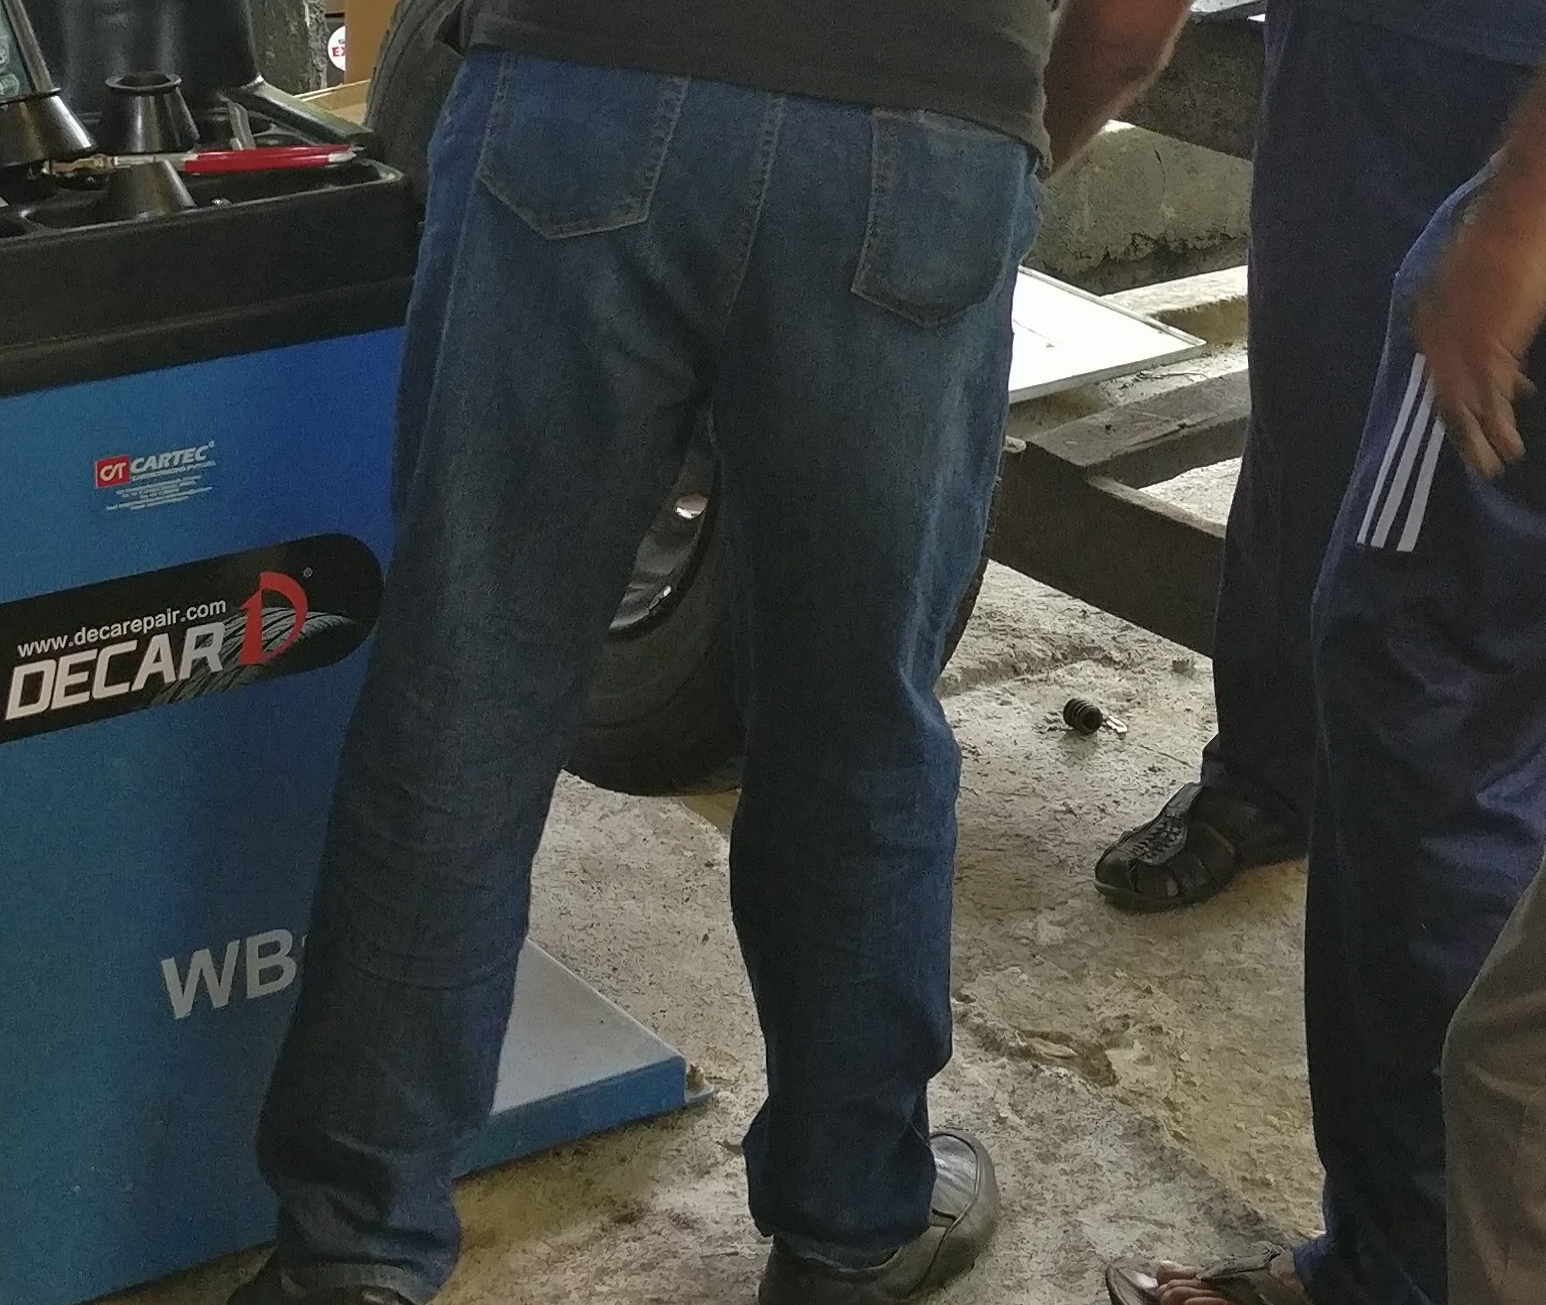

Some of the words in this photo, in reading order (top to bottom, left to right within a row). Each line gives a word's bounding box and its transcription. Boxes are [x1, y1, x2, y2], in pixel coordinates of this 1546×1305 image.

[130, 445, 209, 473] CARTEC
[17, 599, 226, 658] www.decarepair.com
[5, 621, 225, 720] DECAR
